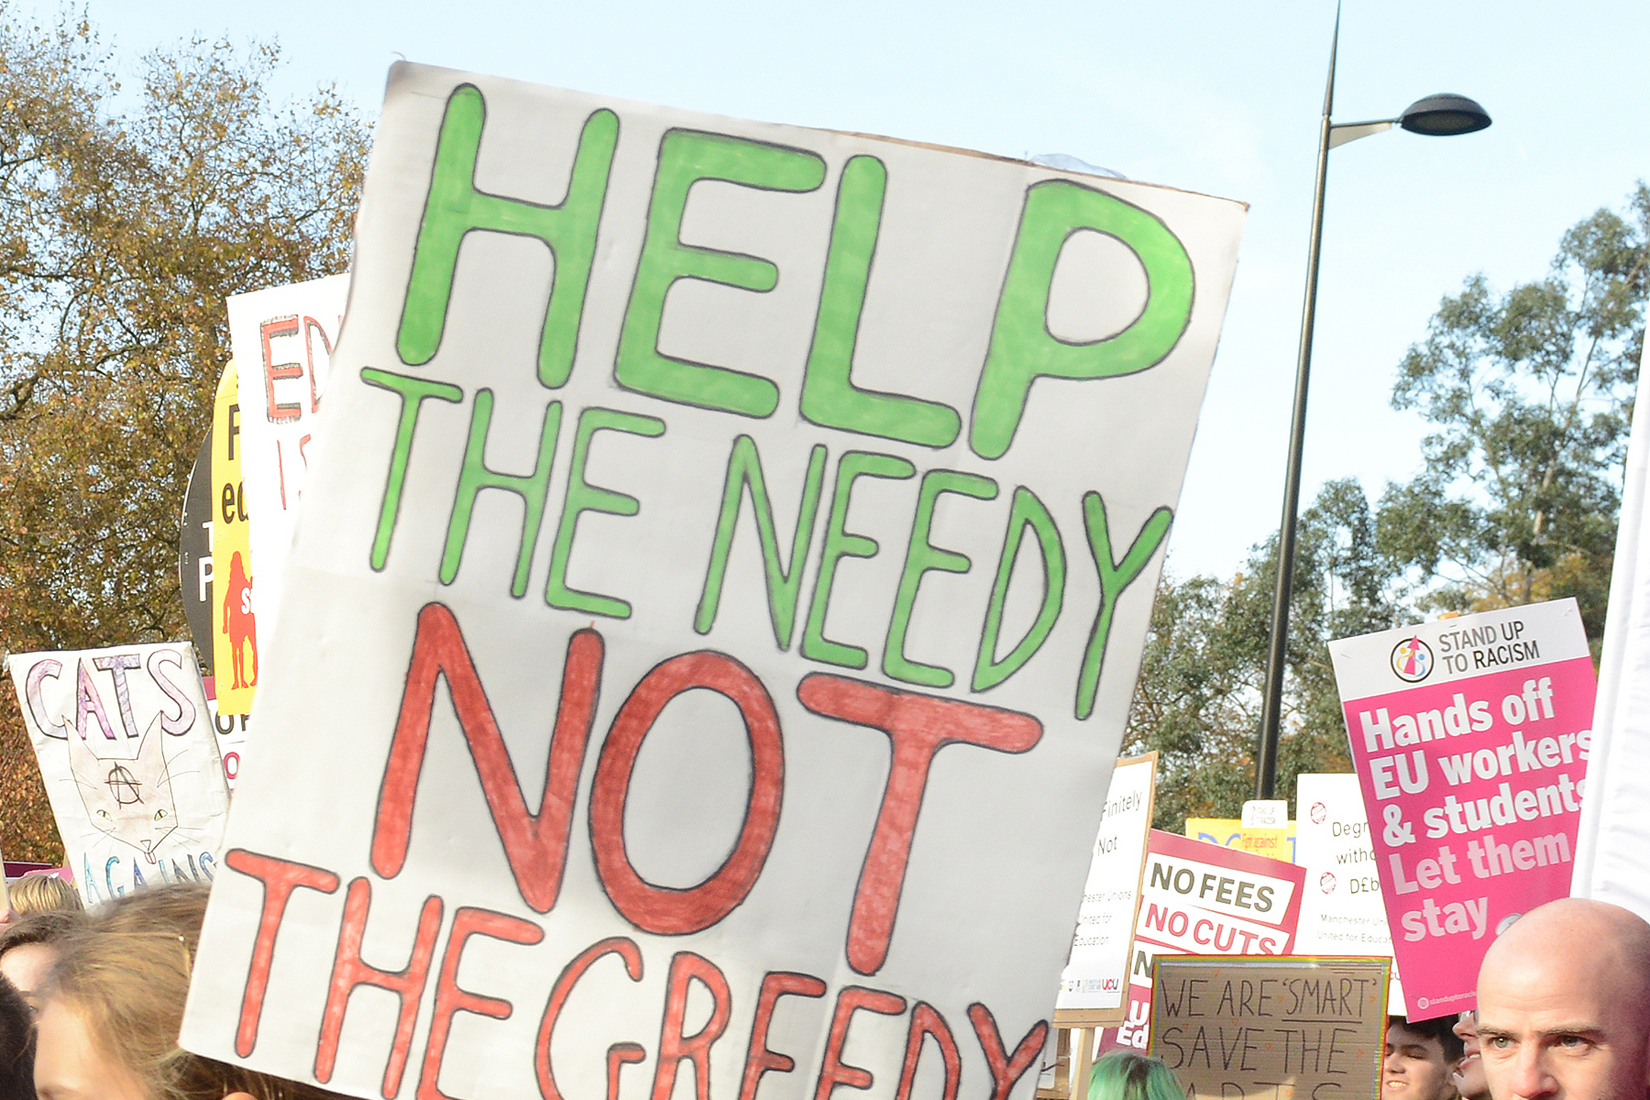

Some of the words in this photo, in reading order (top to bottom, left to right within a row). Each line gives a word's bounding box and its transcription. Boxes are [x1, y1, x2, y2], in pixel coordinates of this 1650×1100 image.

[394, 80, 1197, 461] HELP
[360, 365, 667, 620] THE
[694, 433, 1174, 721] NEEDY
[1438, 624, 1497, 655] STAND
[1500, 620, 1525, 643] UP
[1442, 653, 1469, 675] TO
[1474, 639, 1541, 670] RACISM
[25, 648, 197, 741] CATS
[1358, 693, 1494, 753] Hands
[1502, 676, 1555, 726] off
[370, 601, 1044, 976] NOT
[1368, 749, 1430, 801] EU
[1437, 728, 1592, 787] workers
[1097, 834, 1118, 858] Not
[1331, 821, 1369, 839] Degr
[1382, 804, 1416, 848] &
[83, 850, 218, 904] AGAINS
[1336, 847, 1376, 866] witho
[1388, 845, 1461, 896] Let
[1466, 831, 1572, 880] them
[1150, 862, 1195, 896] NO
[1199, 872, 1275, 913] FEES
[1349, 877, 1380, 895] D£b
[1144, 902, 1190, 938] NO
[1192, 918, 1277, 956] CUTS
[1320, 912, 1371, 926] Manchester
[1360, 932, 1393, 945] Educat
[1400, 896, 1489, 943] stay
[1160, 979, 1209, 1018] WE
[1216, 979, 1279, 1018] ARE
[1160, 1025, 1265, 1072] SAVE
[1274, 1027, 1358, 1074] THE
